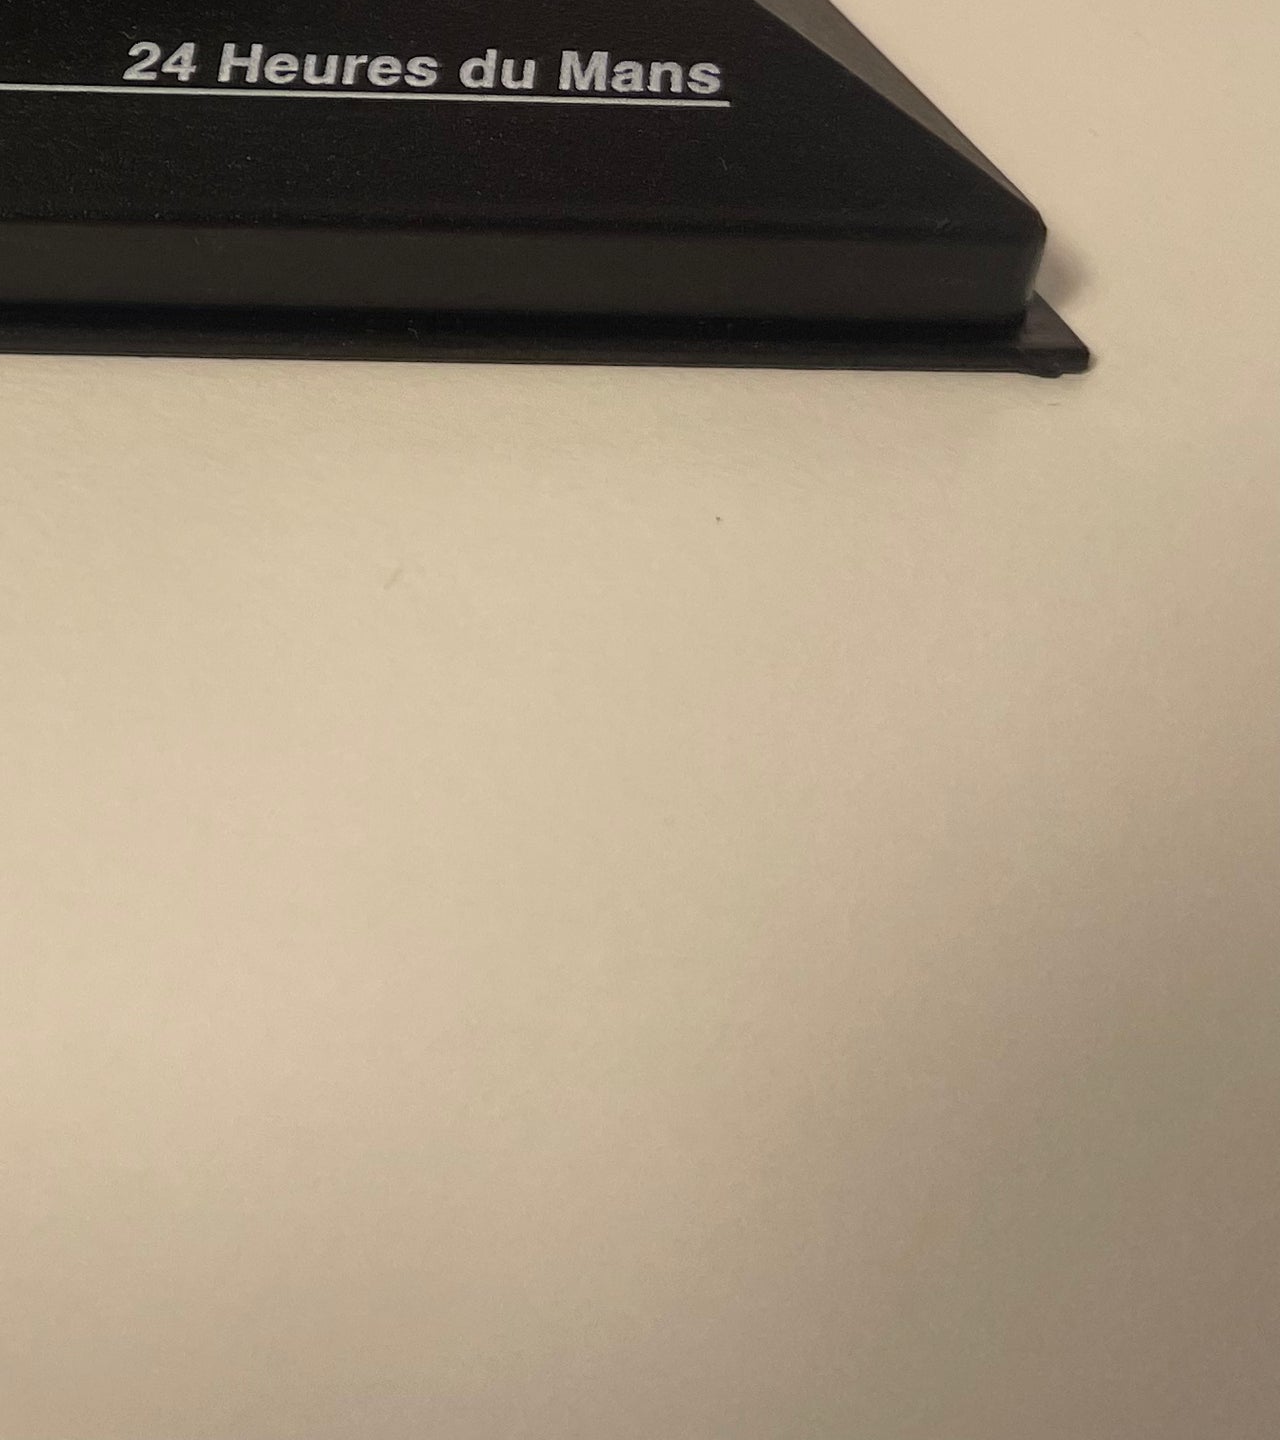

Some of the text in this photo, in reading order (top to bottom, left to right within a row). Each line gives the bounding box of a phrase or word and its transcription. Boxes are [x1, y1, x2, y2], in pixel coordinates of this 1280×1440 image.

[122, 41, 723, 95] 24 Heures du Mans
